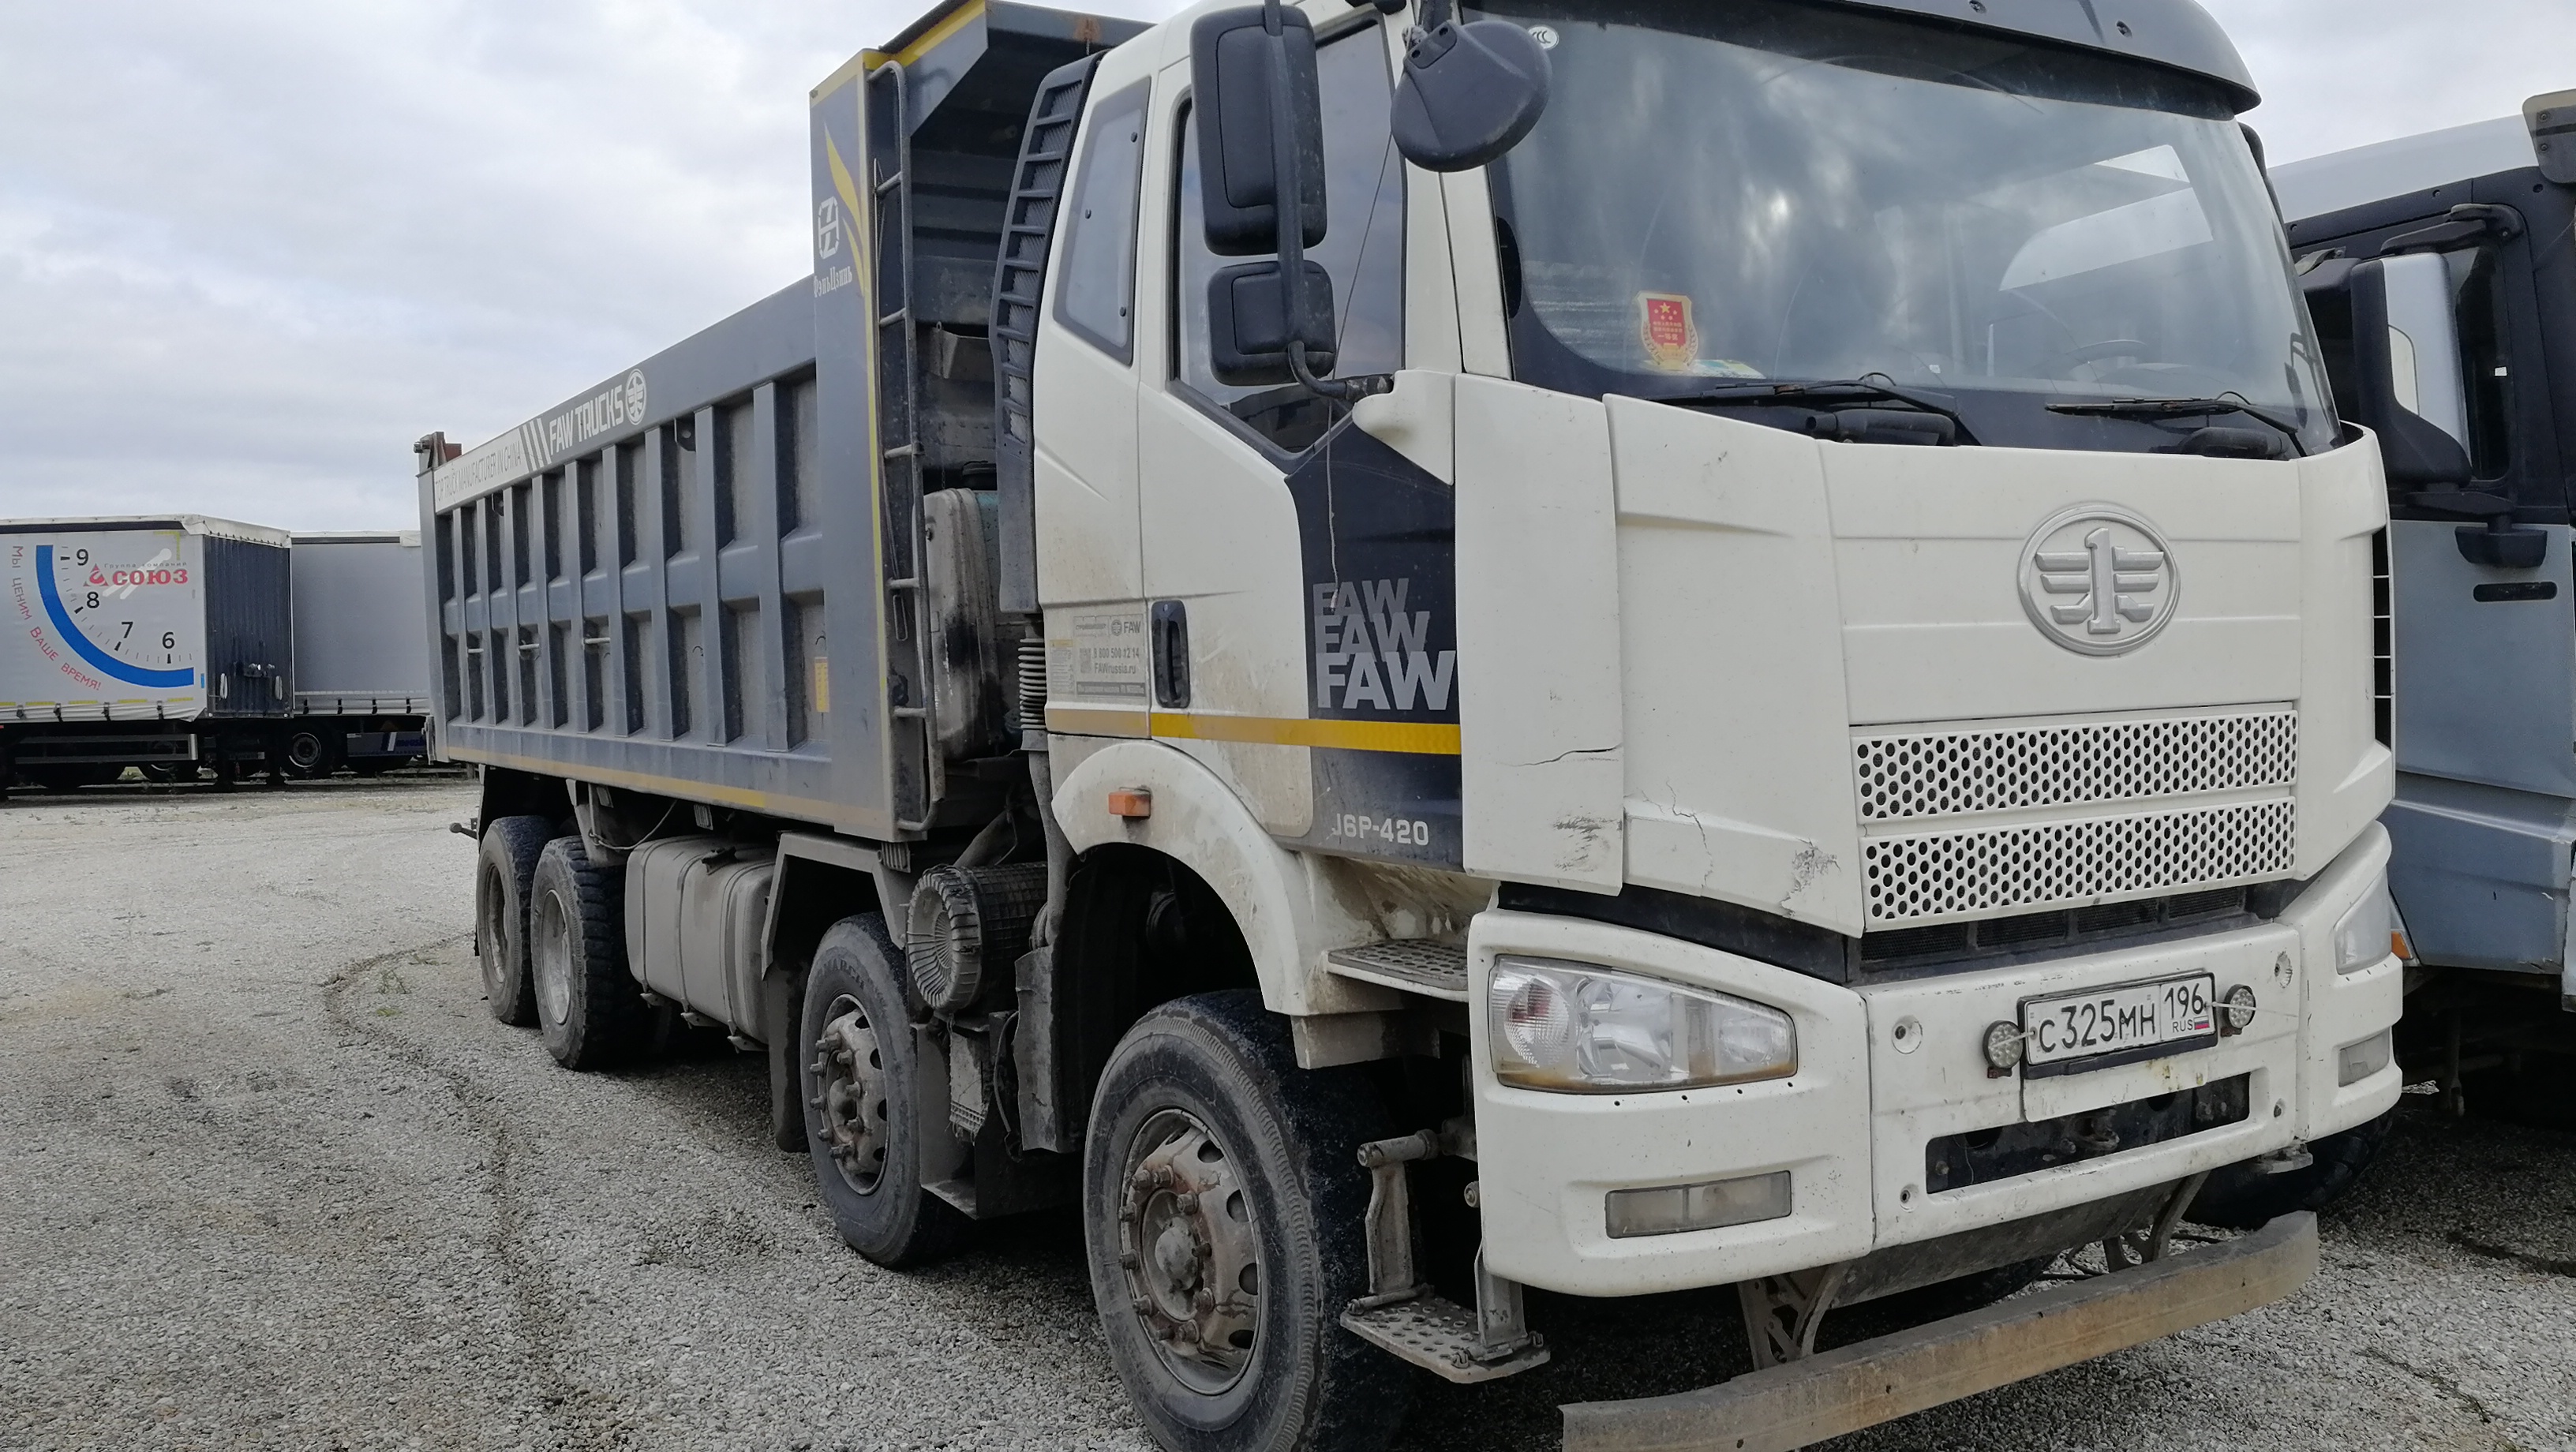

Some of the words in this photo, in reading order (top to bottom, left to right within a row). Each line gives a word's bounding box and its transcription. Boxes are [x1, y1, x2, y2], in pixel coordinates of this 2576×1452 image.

[549, 410, 574, 456] FAW
[575, 384, 623, 442] TRUCKS
[77, 548, 88, 566] 9
[112, 569, 188, 586] СОЮЗ
[87, 591, 99, 608] 8
[1313, 578, 1409, 623] FAW
[122, 621, 133, 638] 7
[1124, 621, 1141, 634] FAW
[1315, 611, 1431, 662] FAW
[162, 631, 175, 649] 6
[1124, 648, 1130, 658] 12
[1133, 648, 1140, 658] 14
[1316, 650, 1456, 710] FAW
[1331, 813, 1429, 846] J6P-420
[2164, 983, 2205, 1019] 196
[2173, 1018, 2194, 1033] RUS
